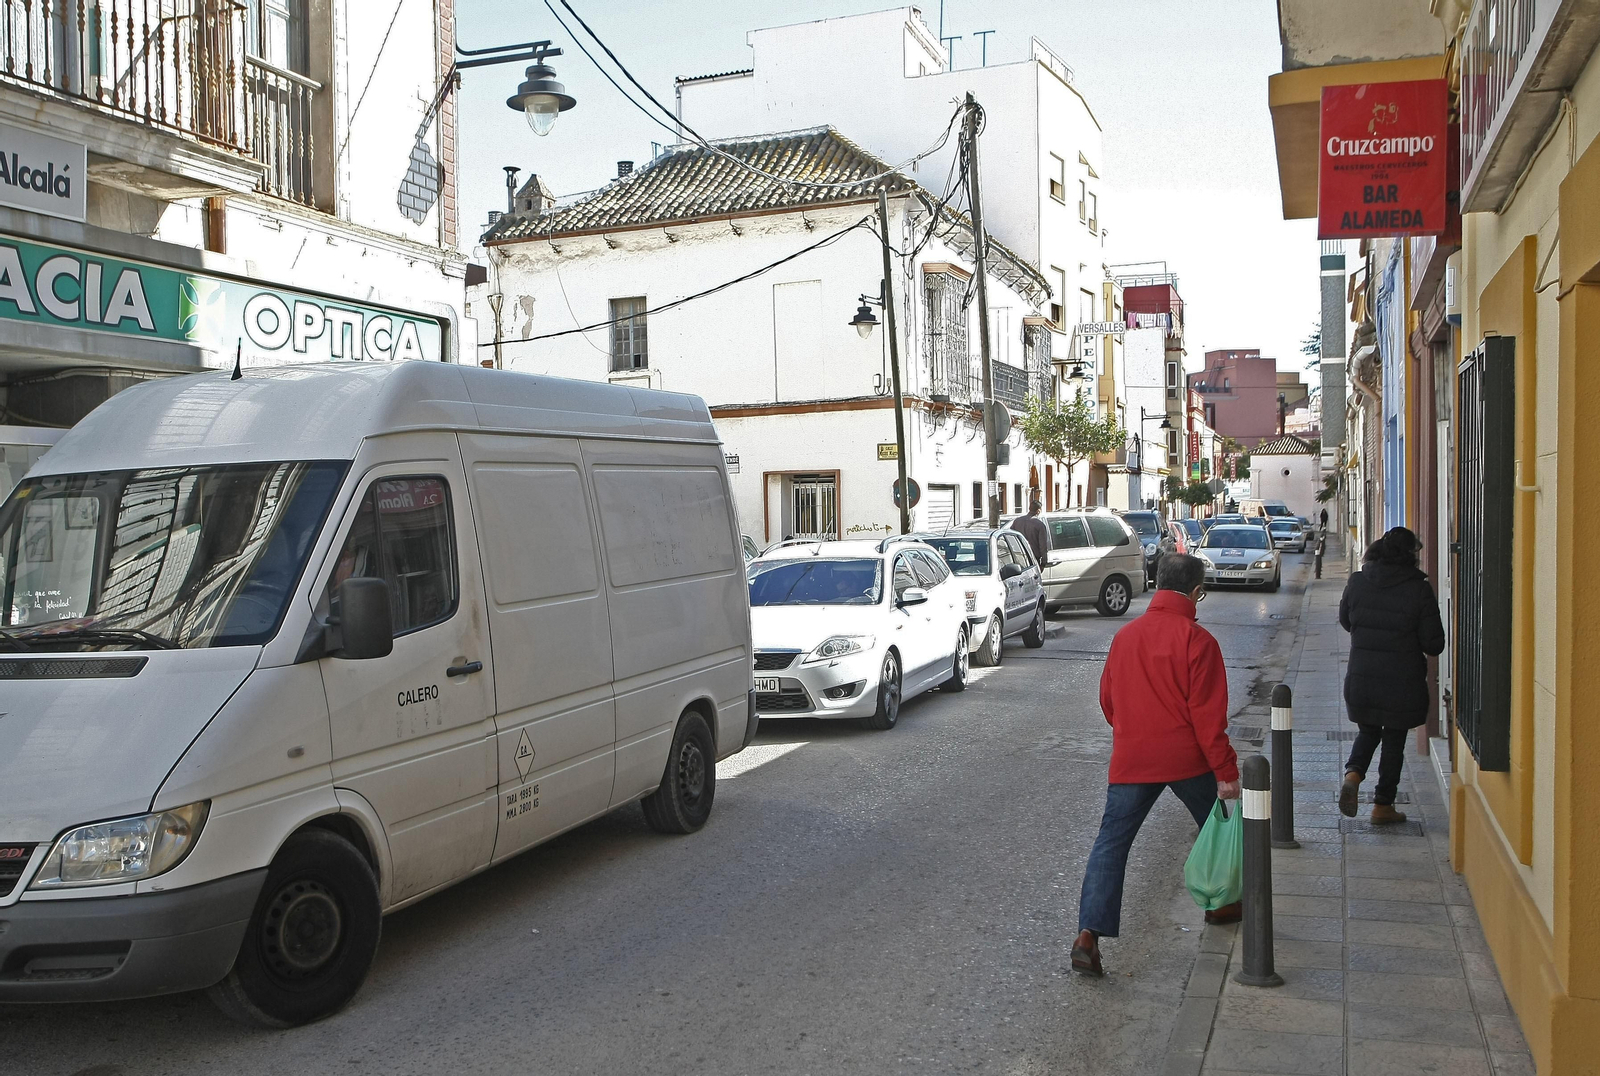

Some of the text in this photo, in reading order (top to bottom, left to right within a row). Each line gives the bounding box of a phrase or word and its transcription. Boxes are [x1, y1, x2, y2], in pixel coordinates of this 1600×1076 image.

[1327, 136, 1433, 157] Cruzcampo
[1334, 161, 1428, 171] MAESTROS CERVECEROS
[1363, 184, 1398, 204] BAR
[1341, 209, 1424, 230] ALAMEDA
[243, 292, 424, 360] OPTICA
[1079, 322, 1124, 334] VERSALLES
[397, 684, 439, 707] CALERO
